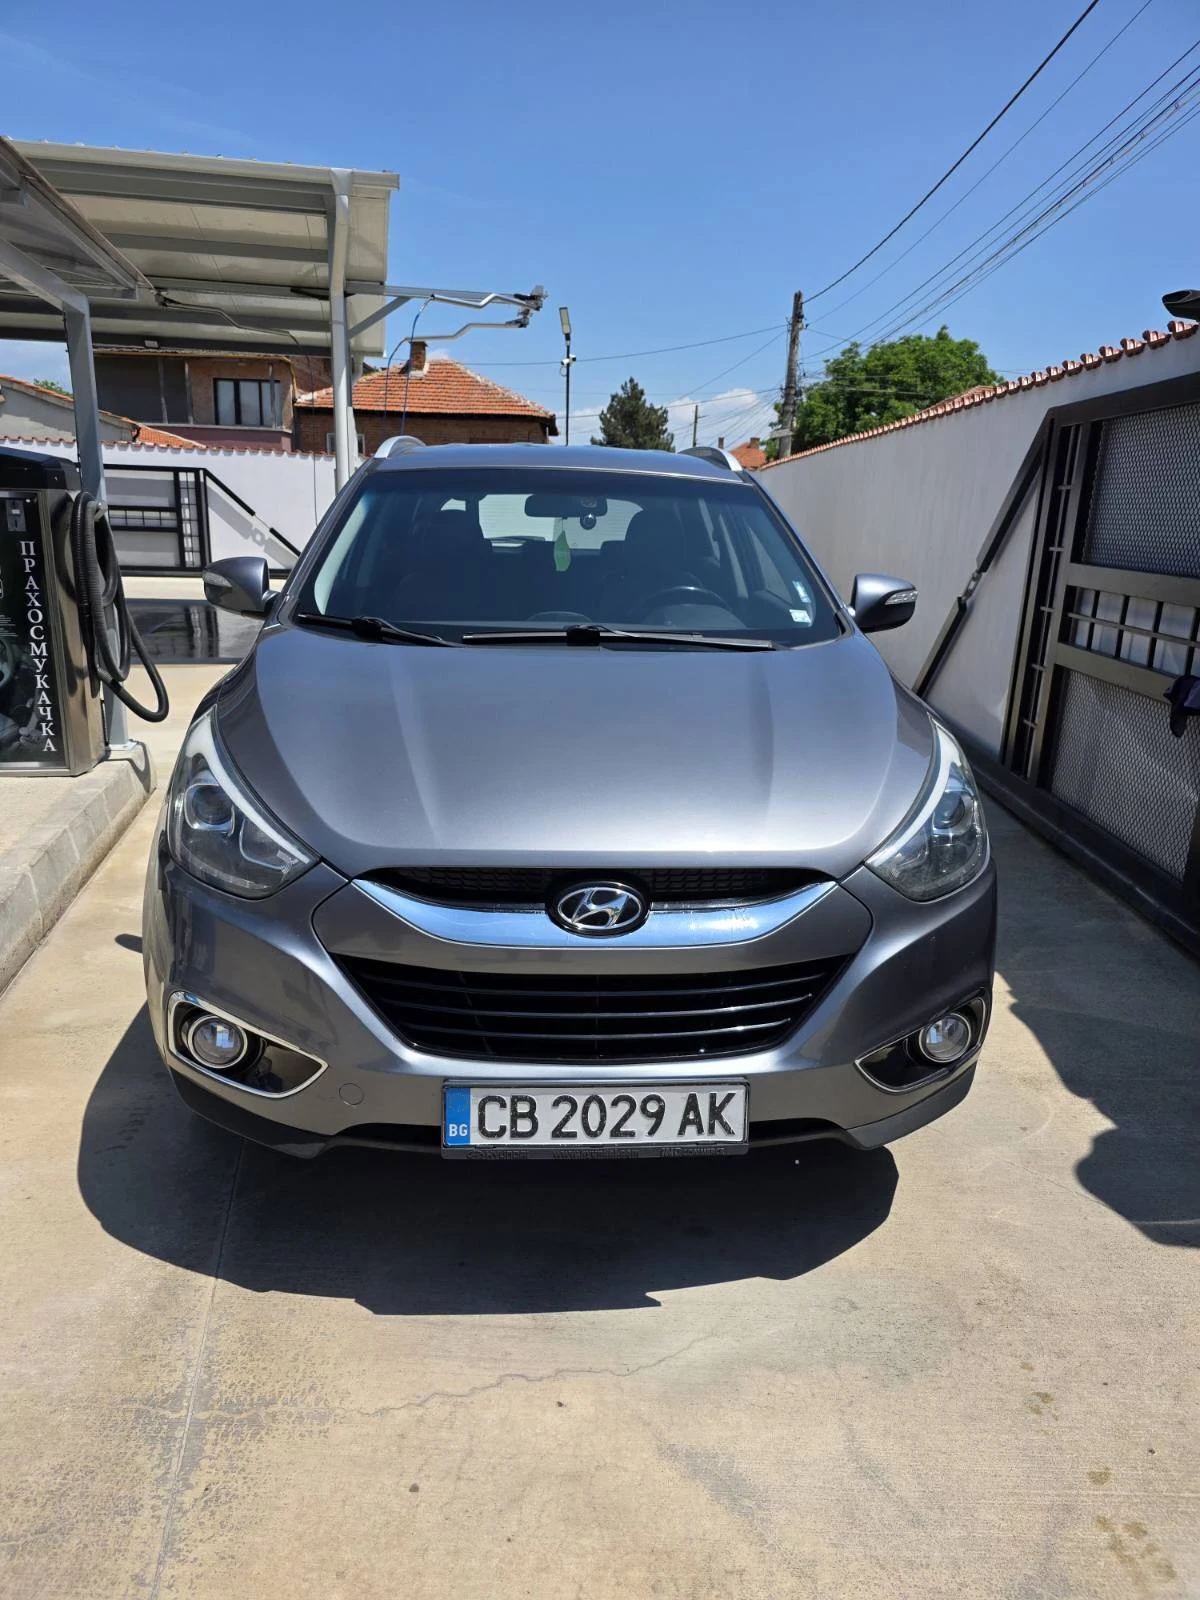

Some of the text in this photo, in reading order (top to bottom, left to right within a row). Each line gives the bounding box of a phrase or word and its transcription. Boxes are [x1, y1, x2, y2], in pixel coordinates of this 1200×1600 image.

[19, 540, 57, 752] ПРАХОСМУКАЧКА
[449, 1123, 468, 1137] BG
[478, 1092, 736, 1139] CB 2029 AK
